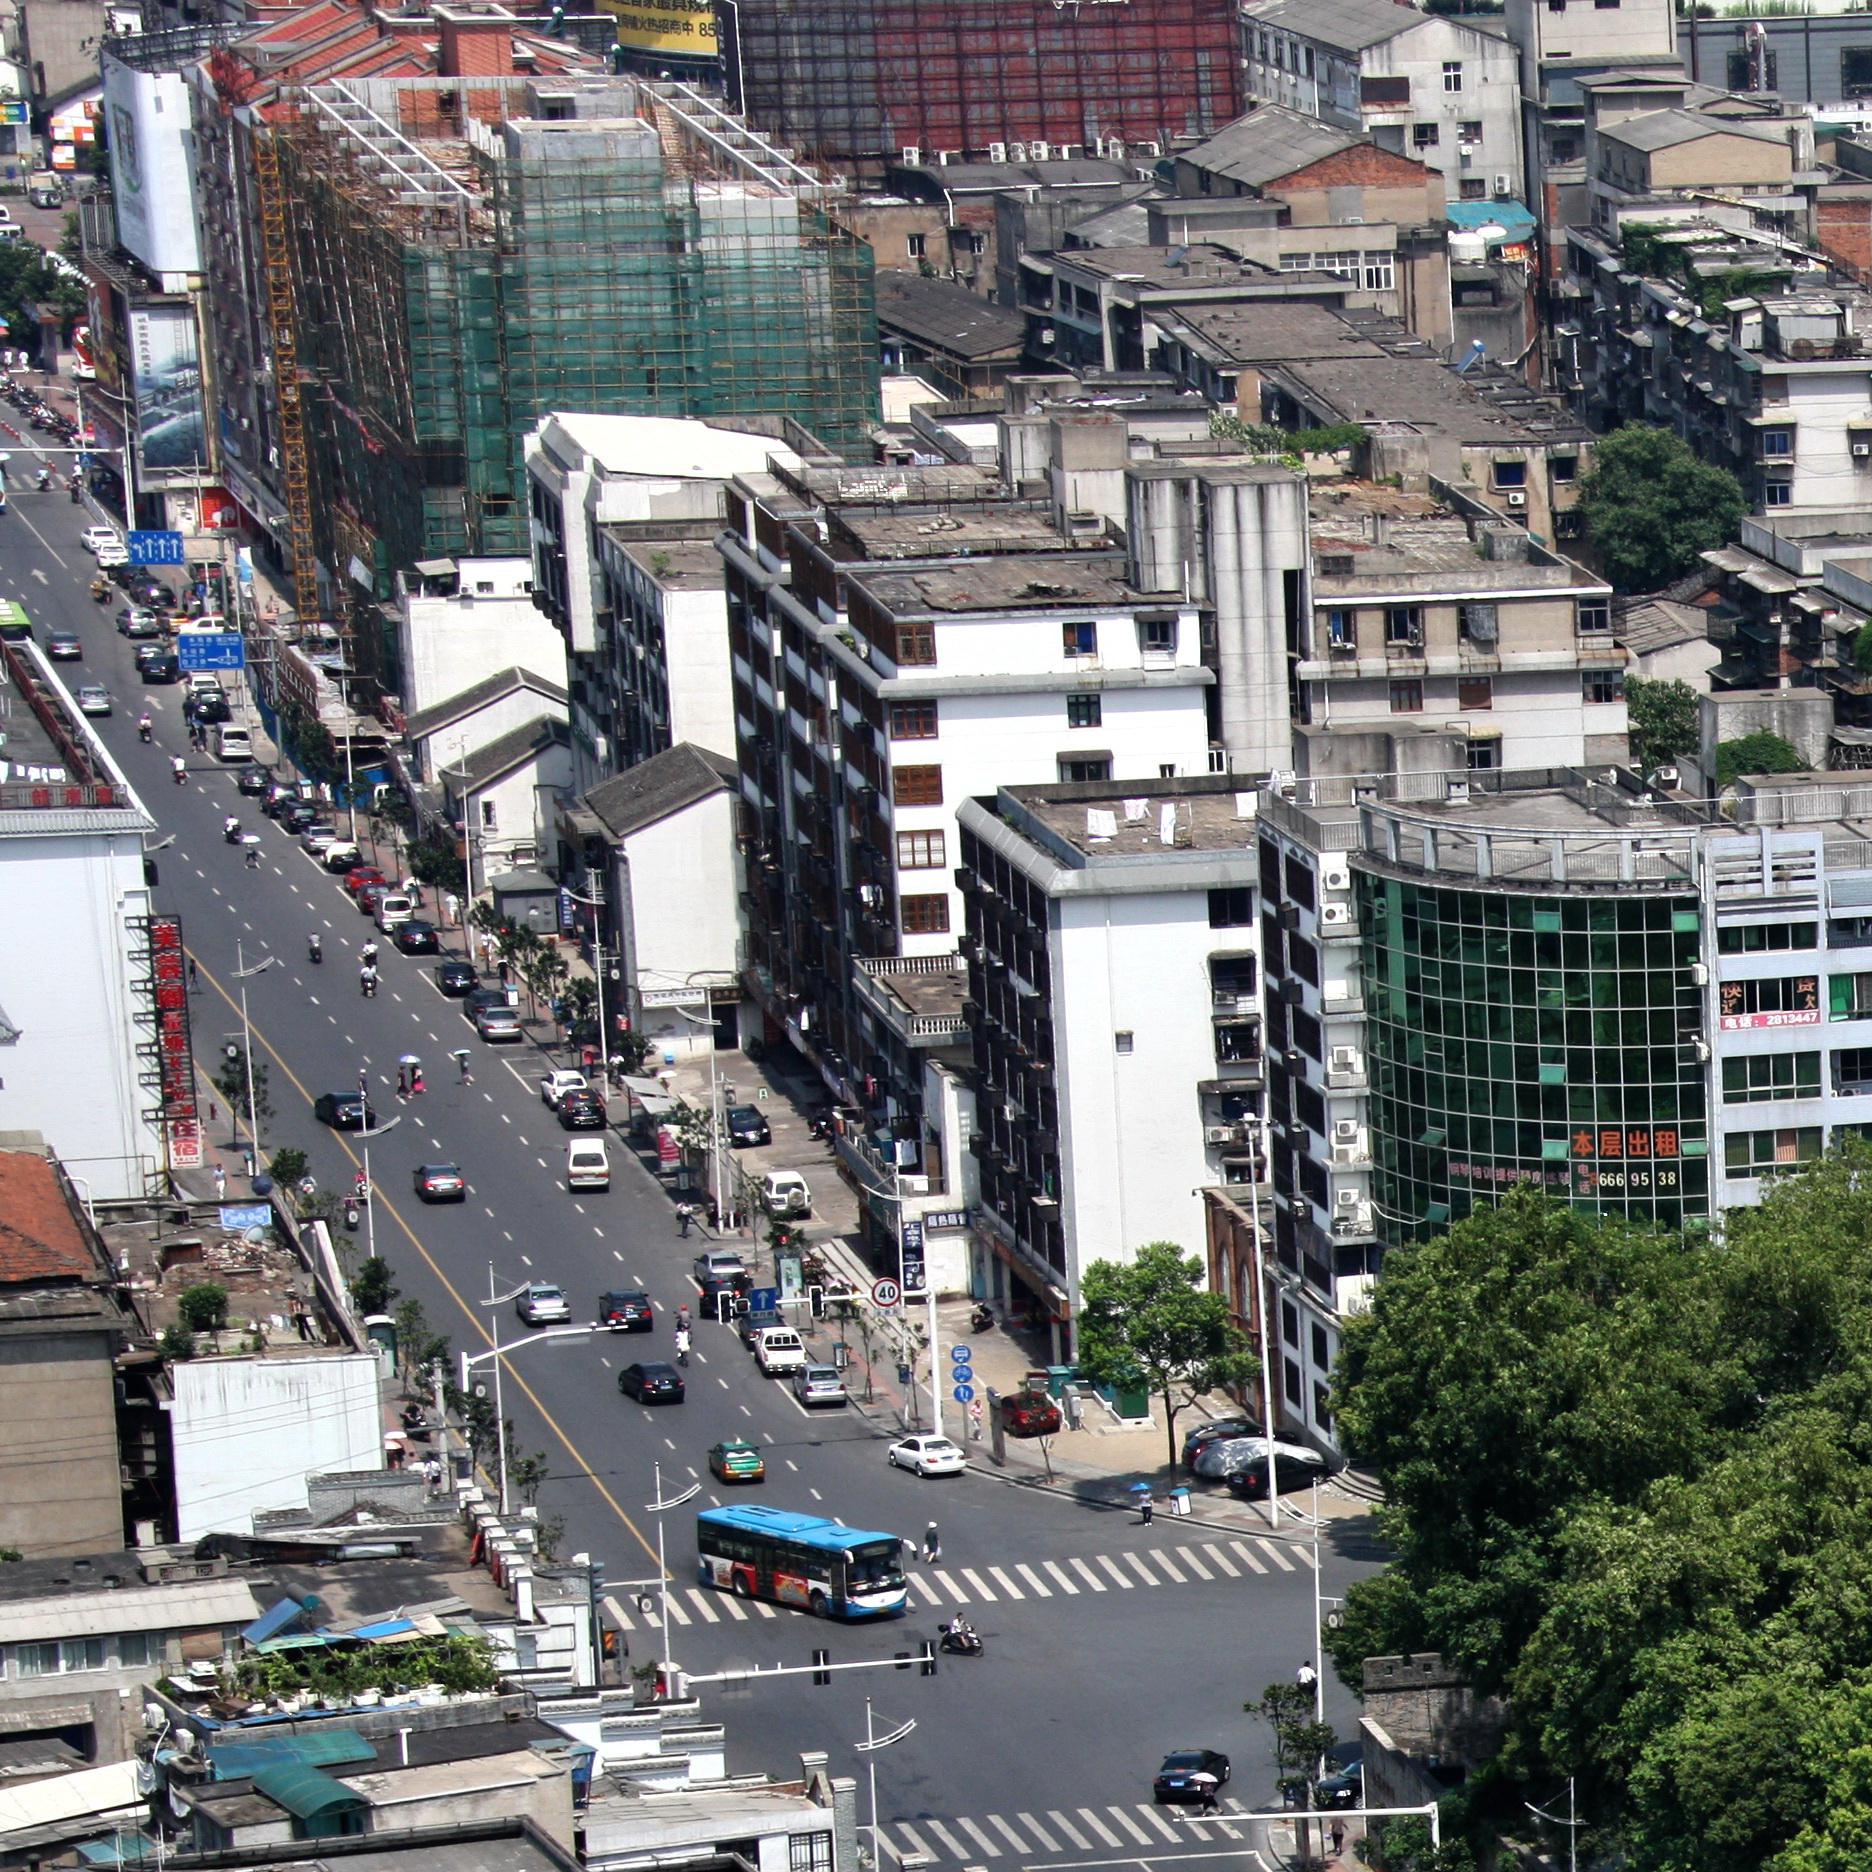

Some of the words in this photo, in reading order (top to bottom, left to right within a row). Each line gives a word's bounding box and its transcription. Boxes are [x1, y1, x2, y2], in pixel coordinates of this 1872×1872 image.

[1767, 1013, 1818, 1025] 2813447
[1572, 1130, 1679, 1158] 本层出租
[878, 1285, 895, 1299] 40
